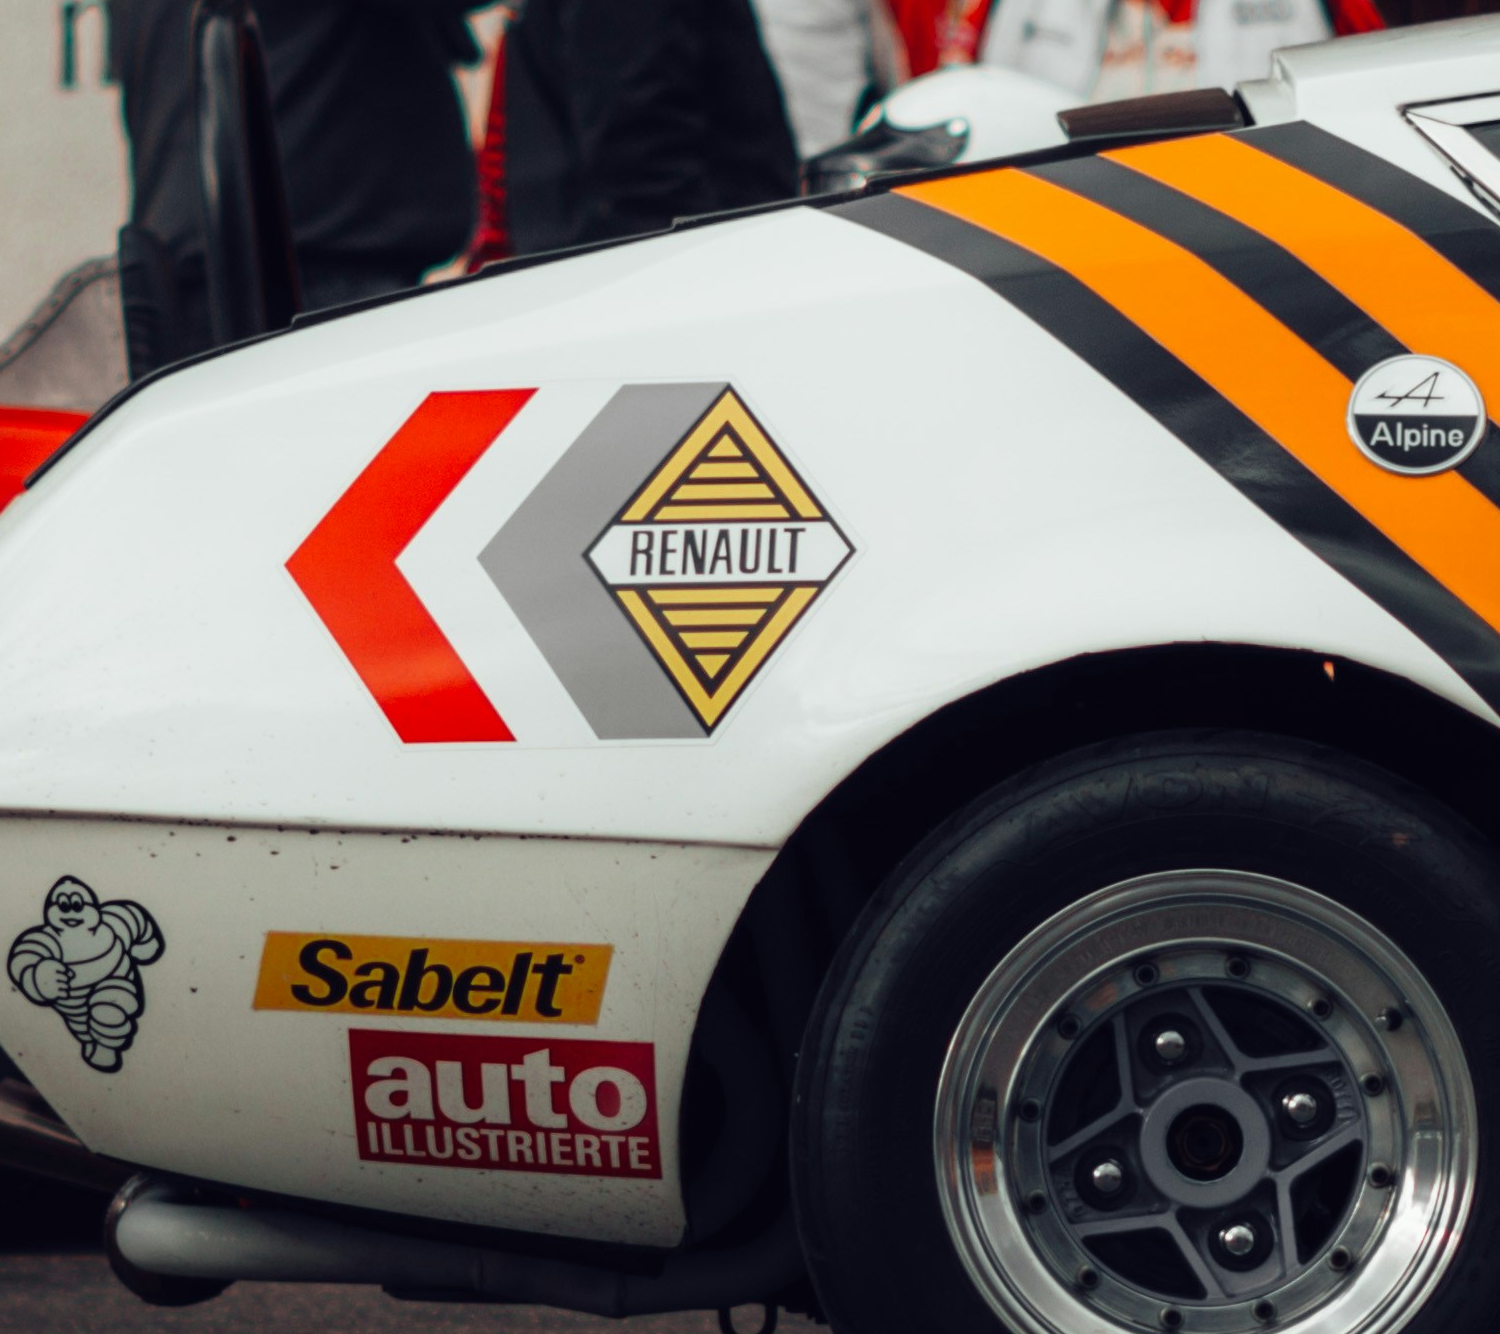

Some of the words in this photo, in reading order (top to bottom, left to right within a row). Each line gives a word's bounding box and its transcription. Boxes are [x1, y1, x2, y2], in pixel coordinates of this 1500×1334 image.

[1370, 421, 1464, 452] Alpine
[629, 527, 807, 576] RENAULT
[291, 939, 573, 1018] Sabelt
[364, 1048, 648, 1132] auto
[367, 1121, 653, 1170] ILLUSTRIERTE
